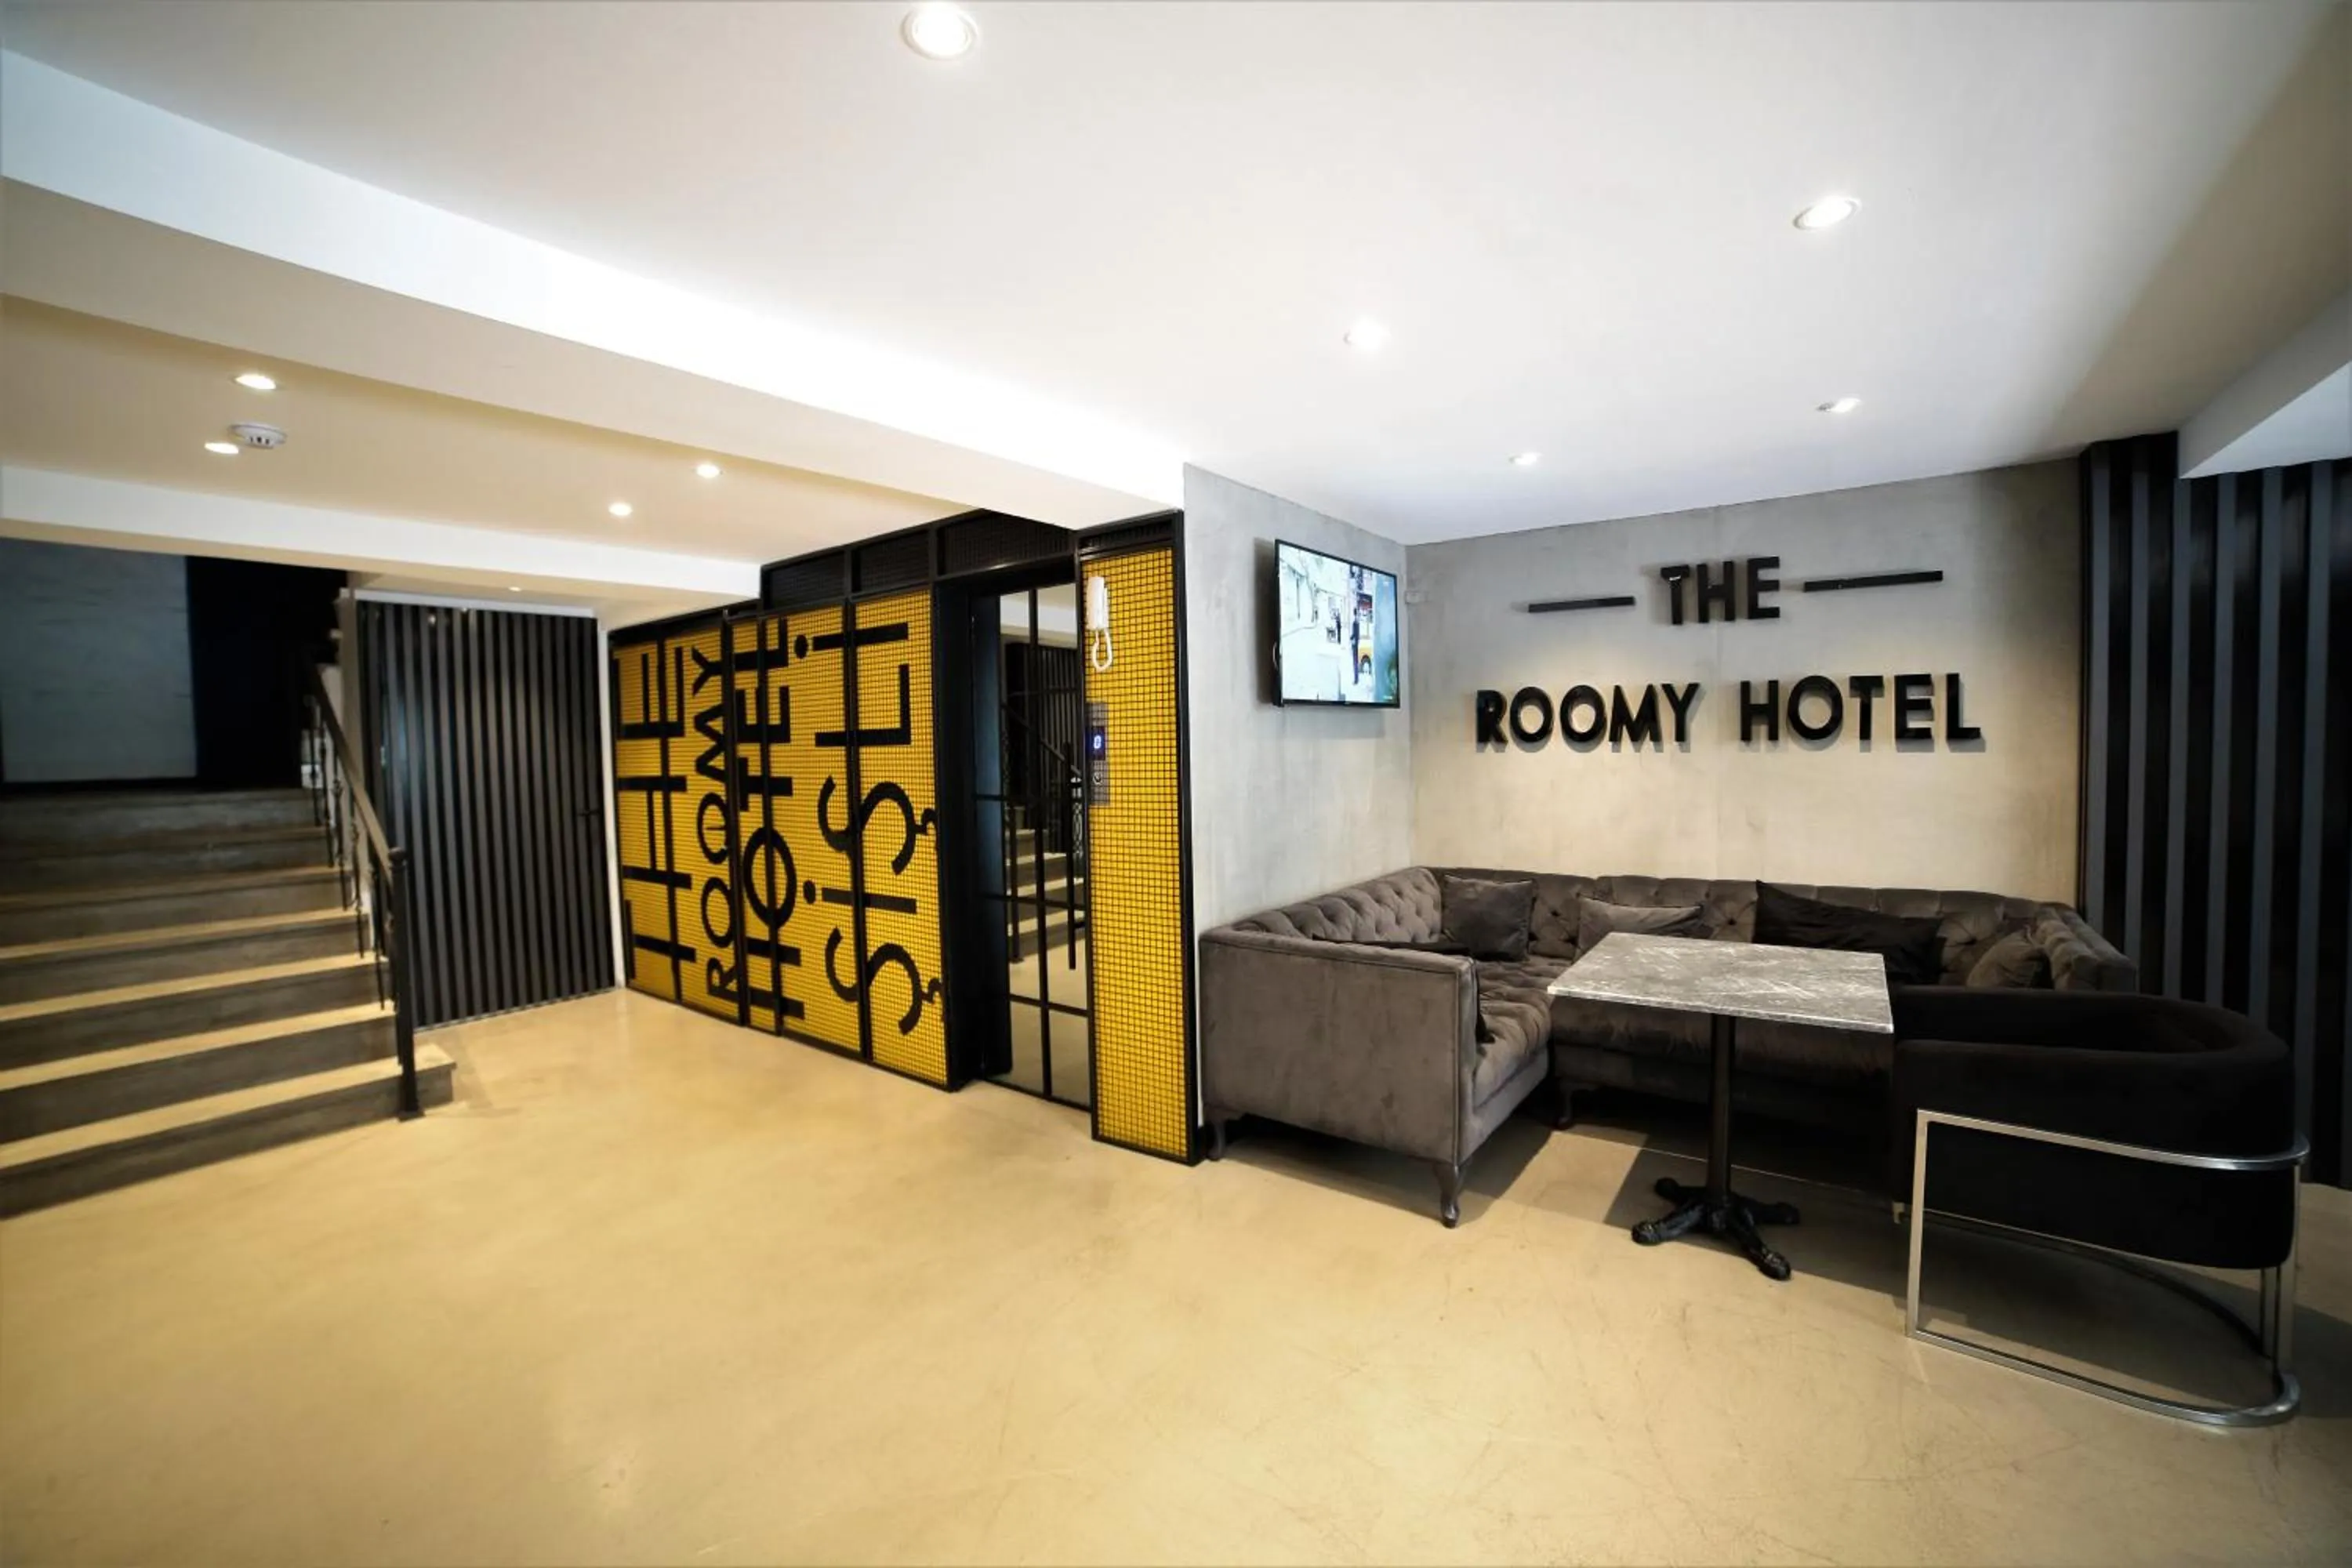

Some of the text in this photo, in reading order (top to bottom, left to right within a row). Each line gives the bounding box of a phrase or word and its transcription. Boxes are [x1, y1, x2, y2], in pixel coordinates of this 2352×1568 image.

[1475, 673, 1981, 743] ROOMY HOTEL
[1661, 556, 1780, 626] THE
[613, 646, 697, 979] THE
[691, 646, 743, 1004] ROOMY
[731, 616, 805, 1020] HOTEL
